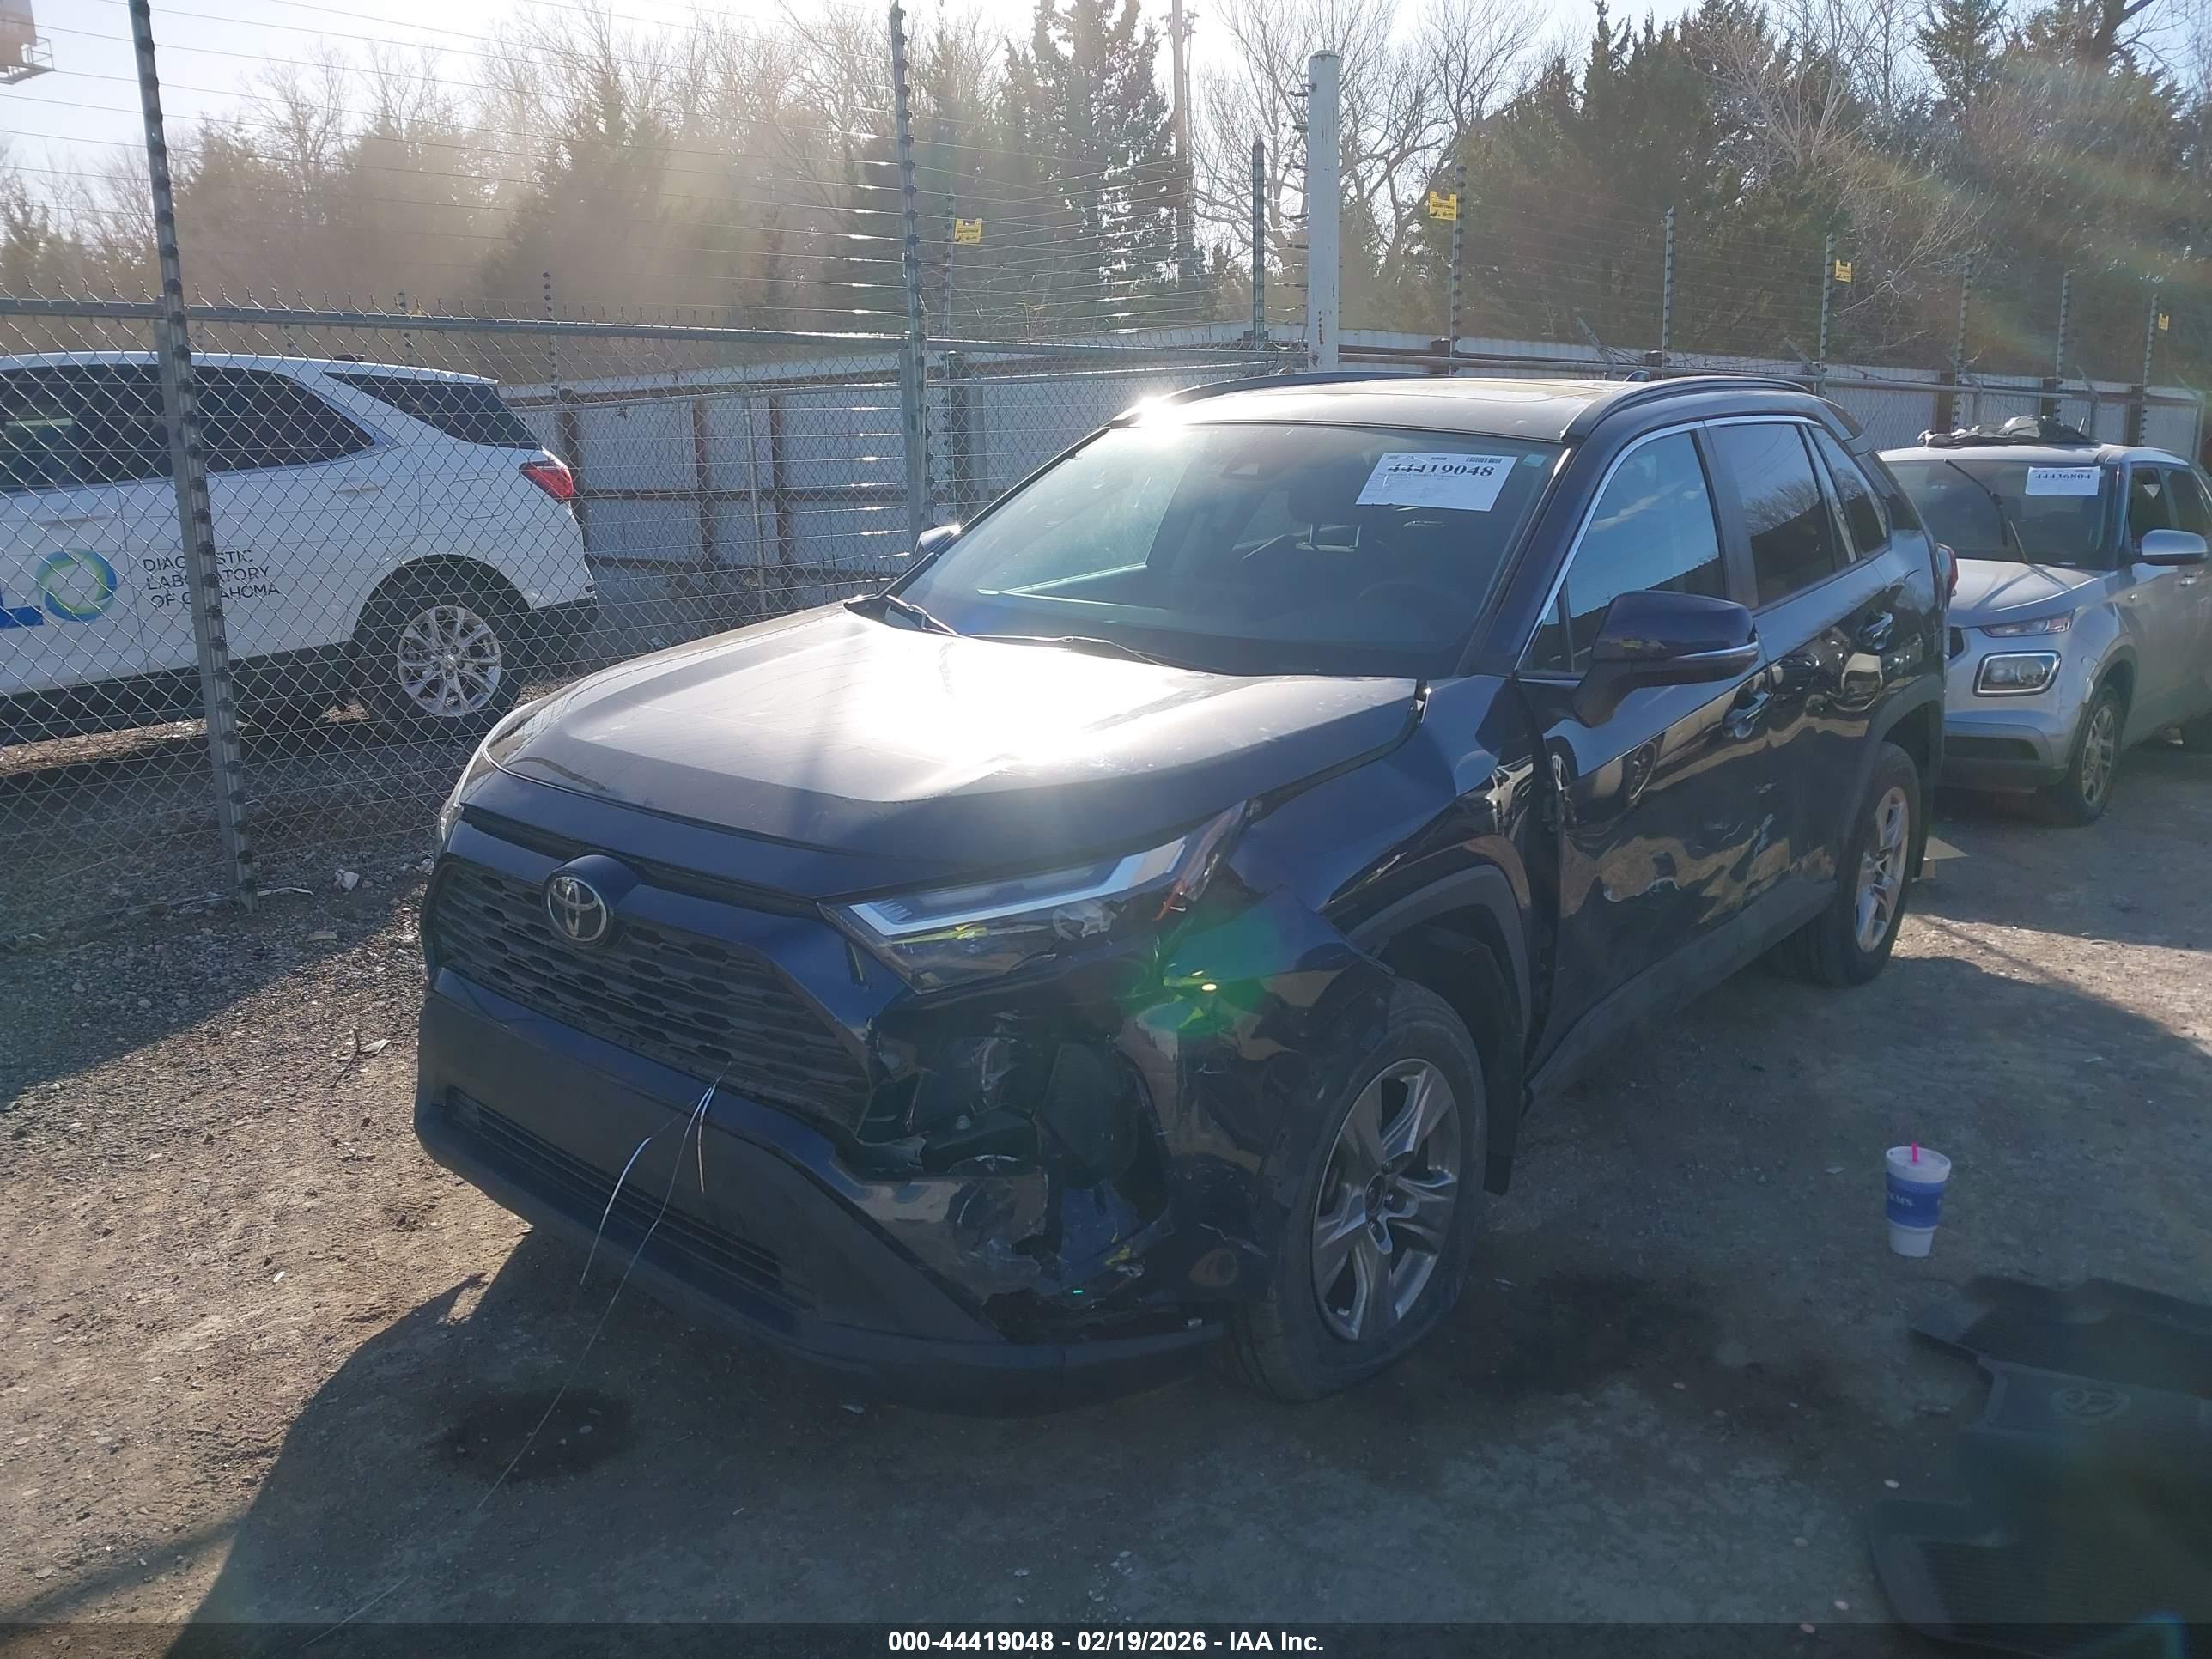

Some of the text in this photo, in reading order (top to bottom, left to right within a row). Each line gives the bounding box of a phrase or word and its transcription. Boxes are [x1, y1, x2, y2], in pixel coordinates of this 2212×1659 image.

[1387, 463, 1495, 477] 44419048
[143, 550, 254, 572] DIAGSTIC
[146, 565, 270, 591] LABTORY
[150, 583, 280, 609] OF OAHOMA
